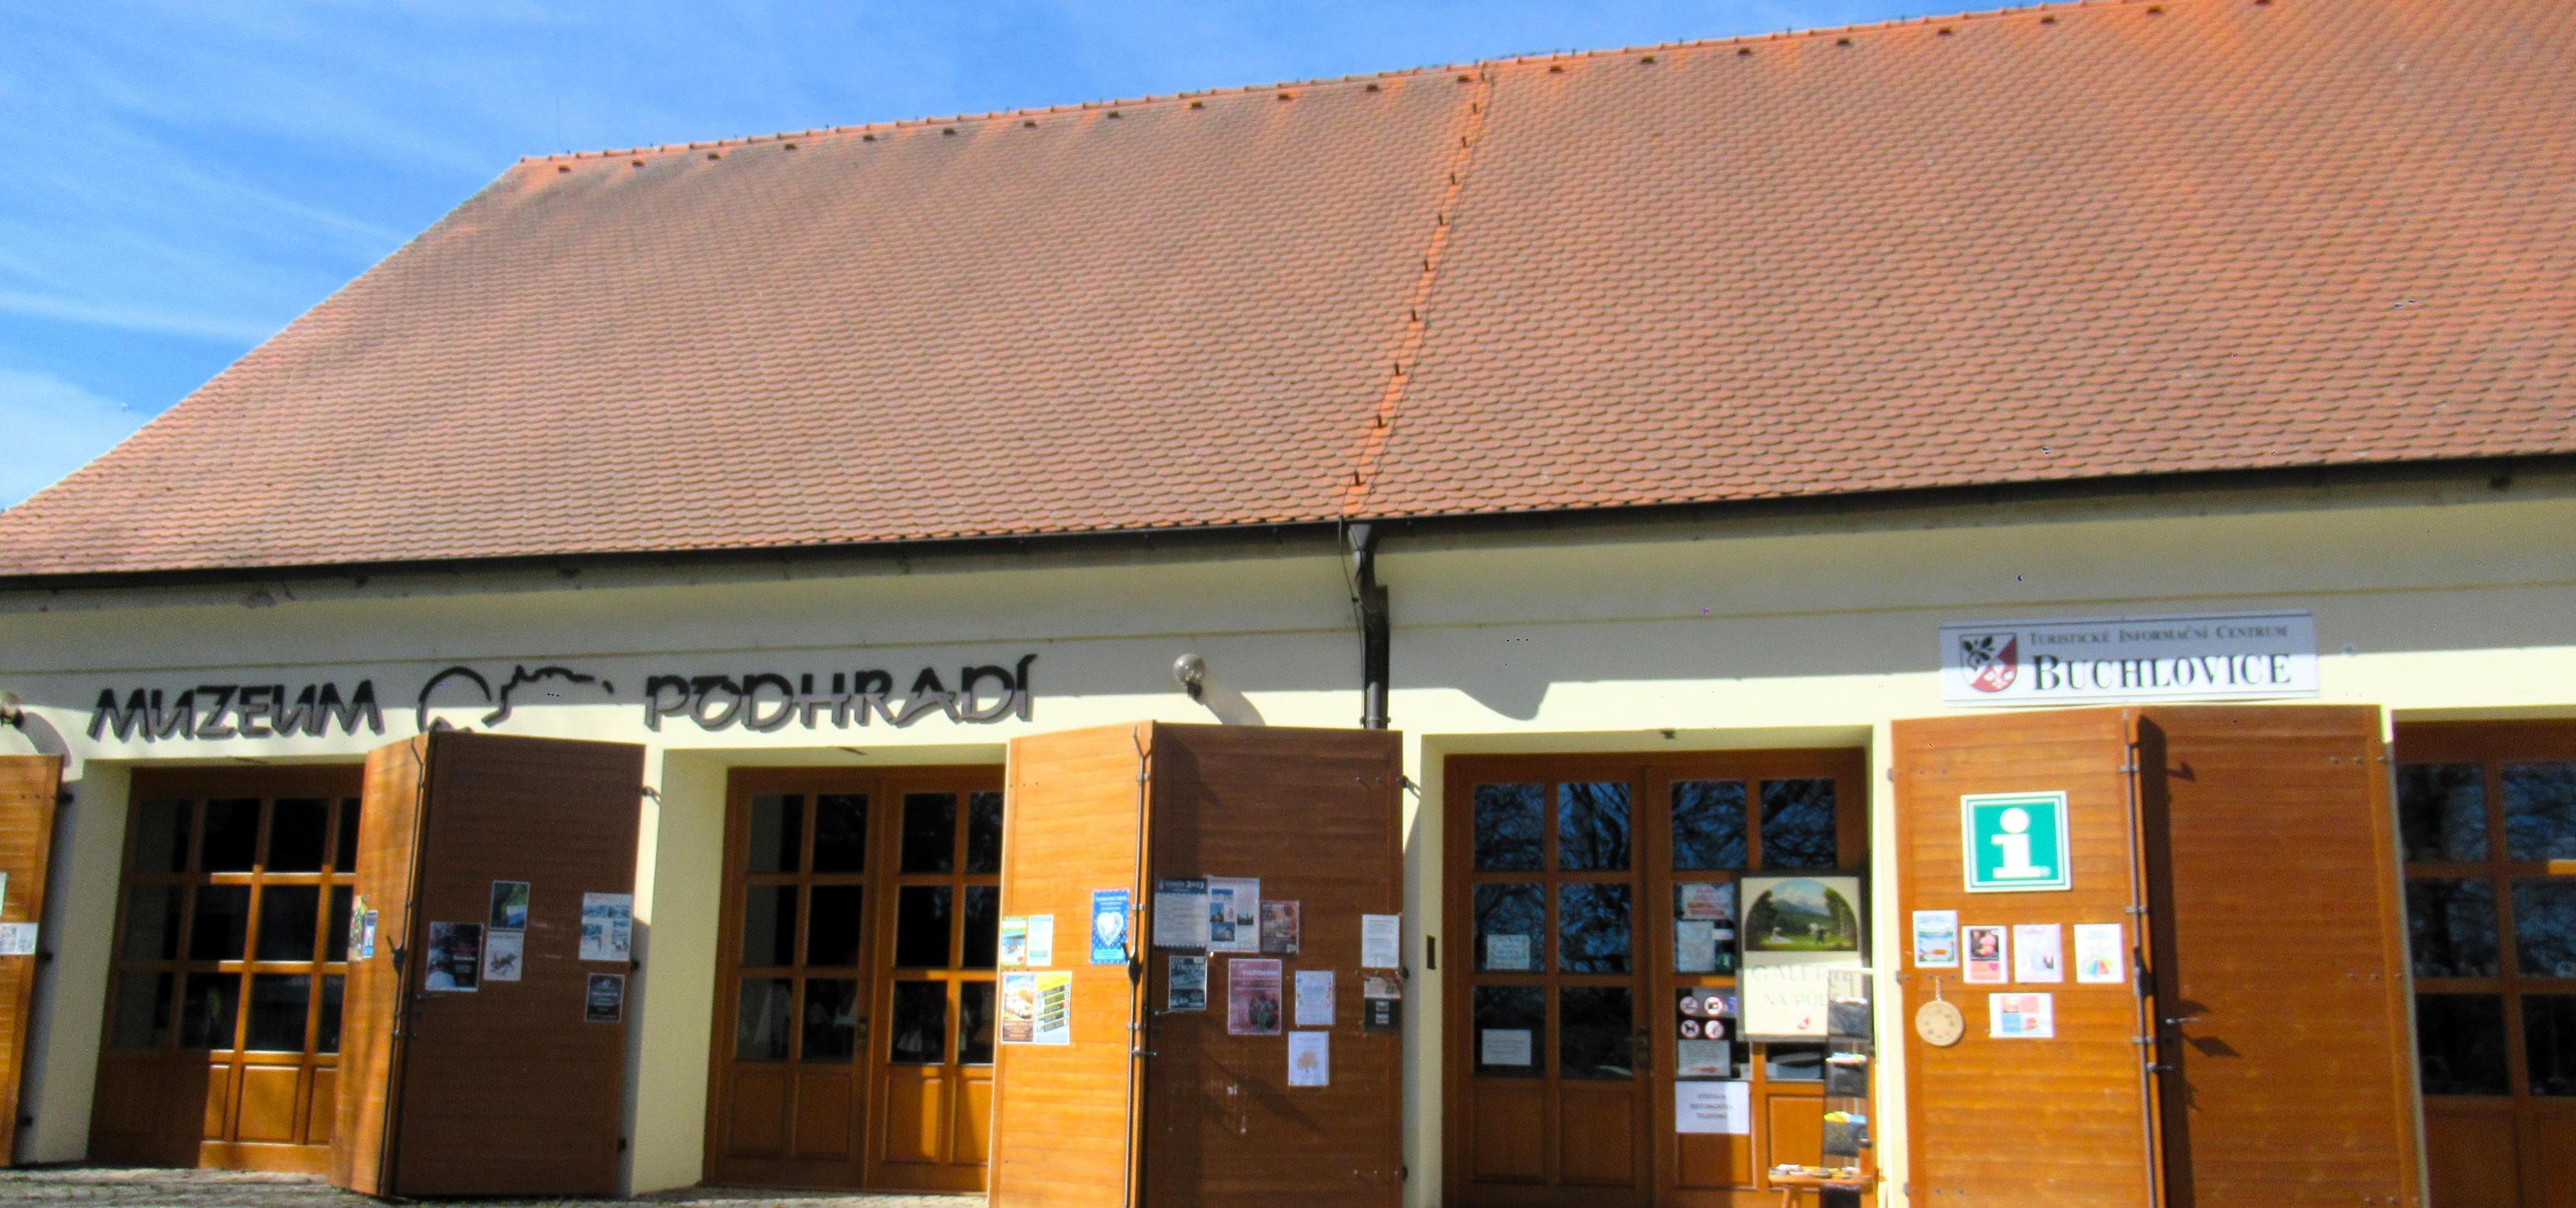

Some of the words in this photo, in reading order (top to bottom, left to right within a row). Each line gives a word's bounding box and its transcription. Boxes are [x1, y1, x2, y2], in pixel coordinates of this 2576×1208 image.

[86, 678, 386, 743] MUZEUM
[644, 653, 1037, 733] PODHRADÍ
[2032, 653, 2291, 691] BUCHLOVICE
